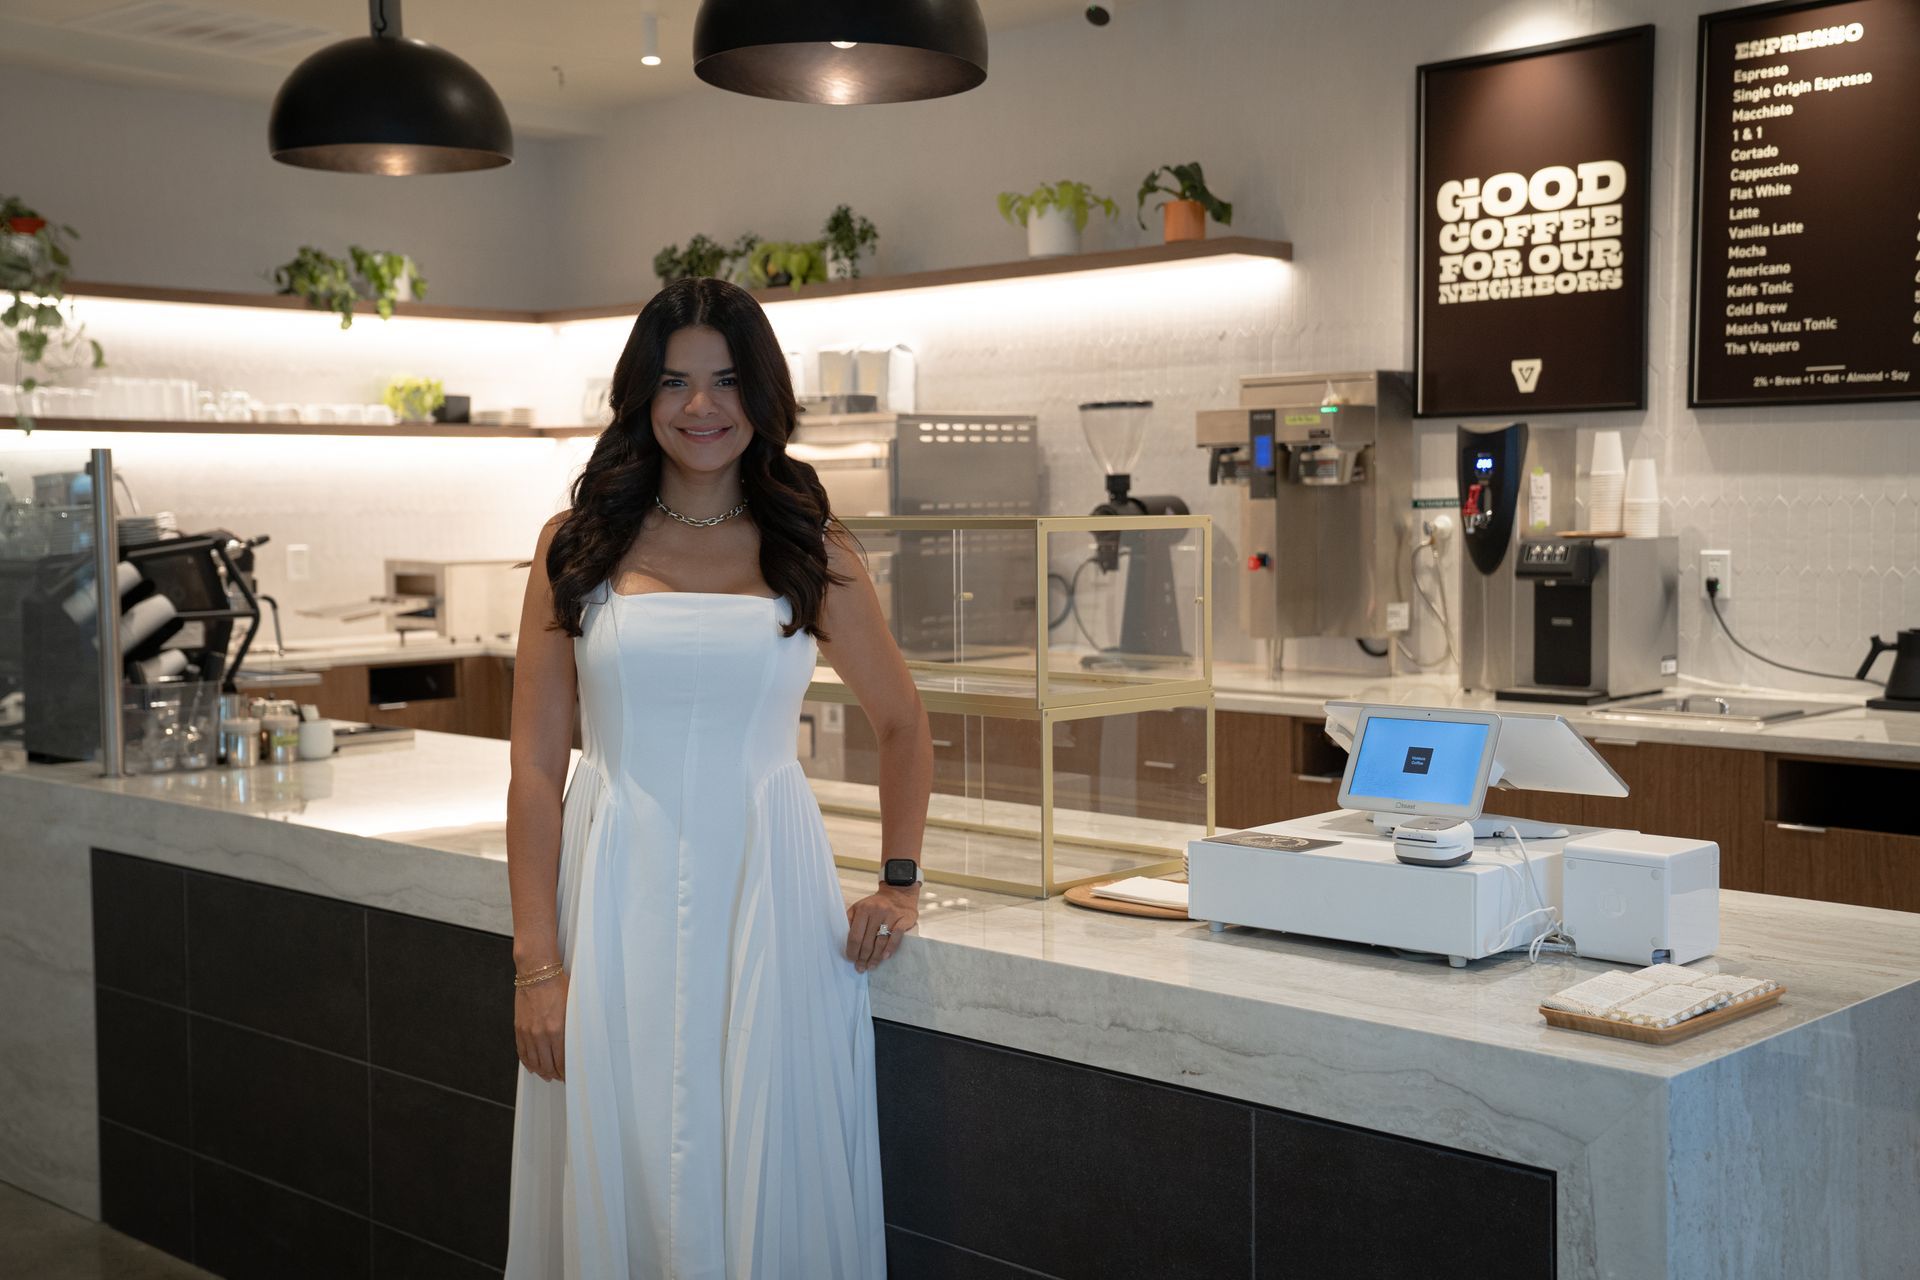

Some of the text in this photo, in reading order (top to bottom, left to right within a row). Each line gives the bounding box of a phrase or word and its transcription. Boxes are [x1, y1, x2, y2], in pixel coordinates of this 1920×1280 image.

[1735, 23, 1863, 59] ESPRESSO
[1734, 65, 1789, 83] Espresso
[1733, 72, 1873, 103] Single Origin Espresso
[1733, 104, 1794, 122] Macchiato
[1733, 126, 1762, 142] 1 & 1
[1731, 145, 1779, 162] Cortado
[1730, 163, 1799, 182] Cappuccino
[1436, 160, 1627, 223] GOOD
[1730, 183, 1792, 201] Flat White
[1729, 207, 1760, 220] Latte
[1438, 203, 1624, 254] COFFEE
[1728, 222, 1804, 239] Vanilla Latte
[1438, 237, 1624, 284] FOR OUR
[1728, 244, 1767, 259] Mocha
[1727, 263, 1791, 278] Americano
[1437, 267, 1624, 305] NEIGHBORS
[1727, 281, 1793, 297] Kaffe Tonic
[1726, 302, 1788, 317] Cold Brew
[1726, 317, 1837, 336] Matcha Yuzu Tonic
[1725, 341, 1800, 355] The Vaquero
[1753, 376, 1768, 387] 2%
[1775, 375, 1801, 386] Breve
[1823, 373, 1839, 384] Oat
[1846, 371, 1883, 382] Almond
[1891, 370, 1910, 381] Soy
